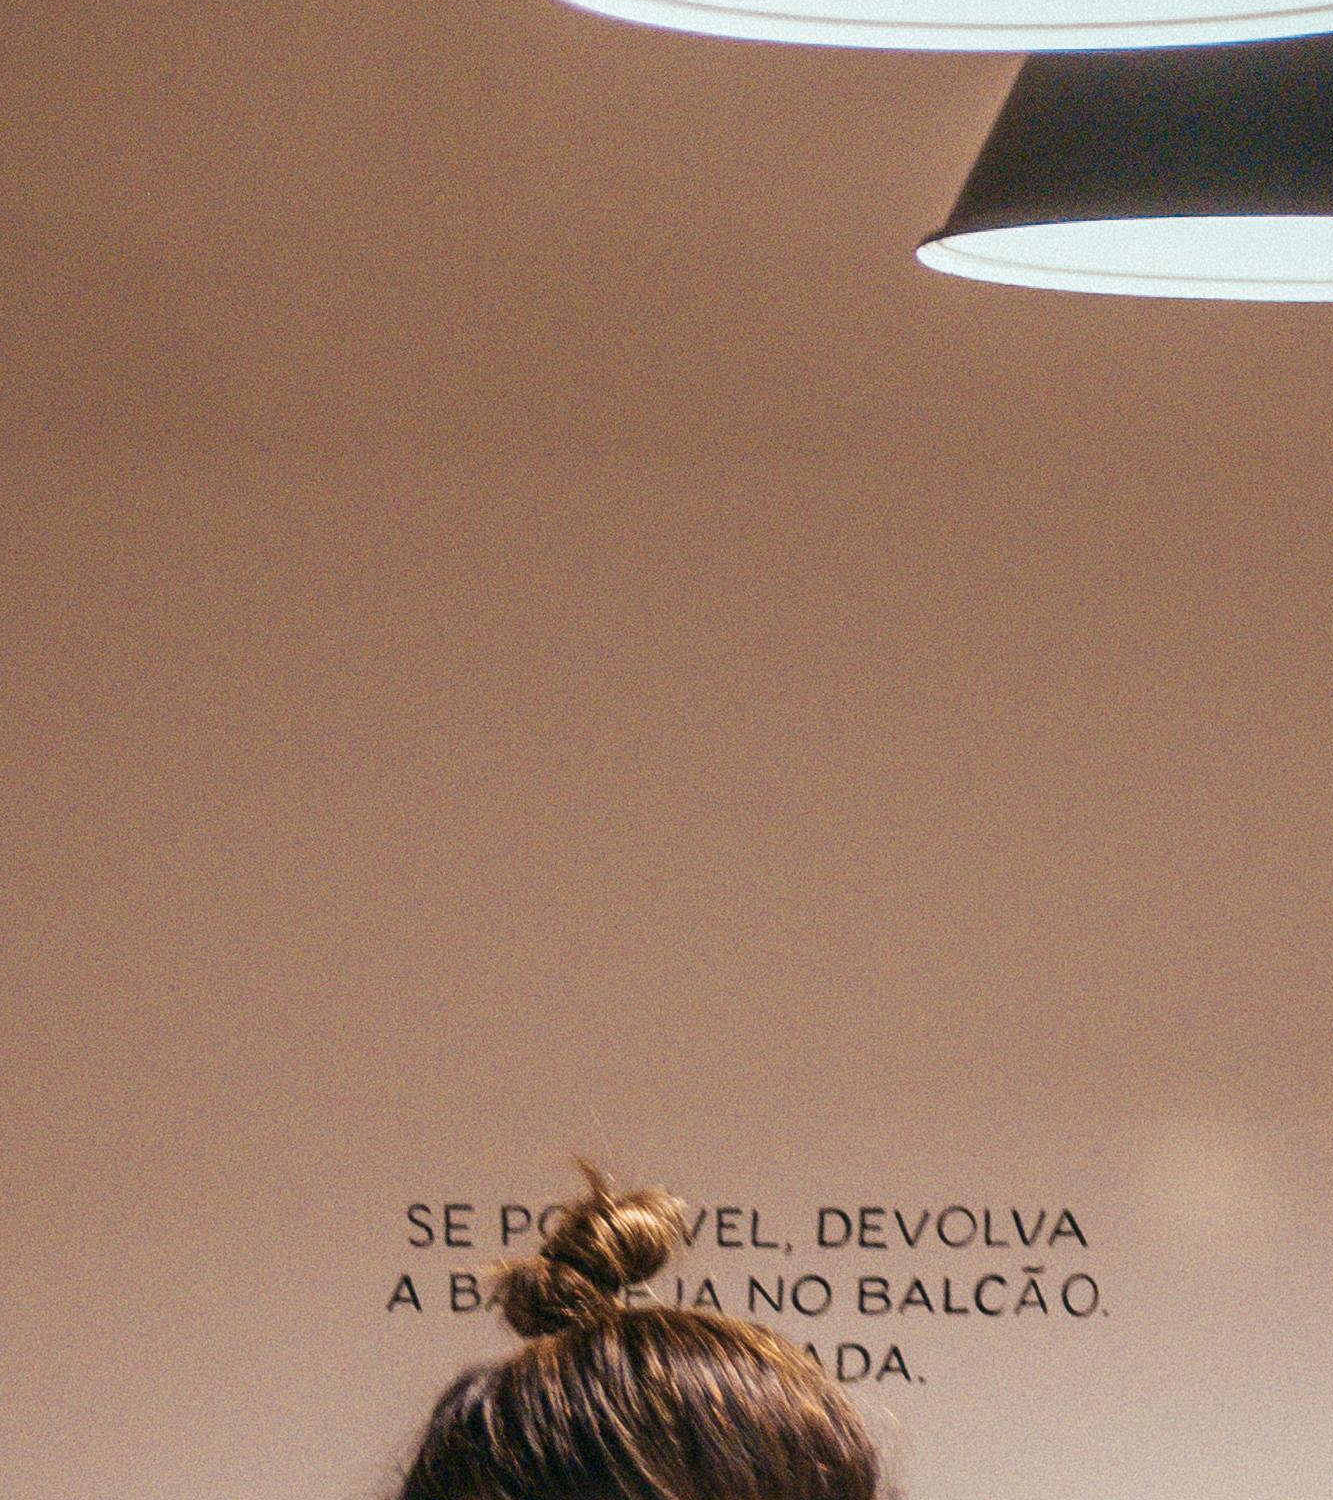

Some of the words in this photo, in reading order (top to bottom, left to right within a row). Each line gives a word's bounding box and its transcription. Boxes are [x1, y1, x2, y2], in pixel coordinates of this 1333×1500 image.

[407, 1202, 474, 1247] SE
[501, 1204, 793, 1254] POVEL,
[817, 1204, 1088, 1249] DEVOLVA
[386, 1273, 422, 1312] A
[748, 1273, 832, 1316] NO
[857, 1265, 1109, 1318] BALCÃO.
